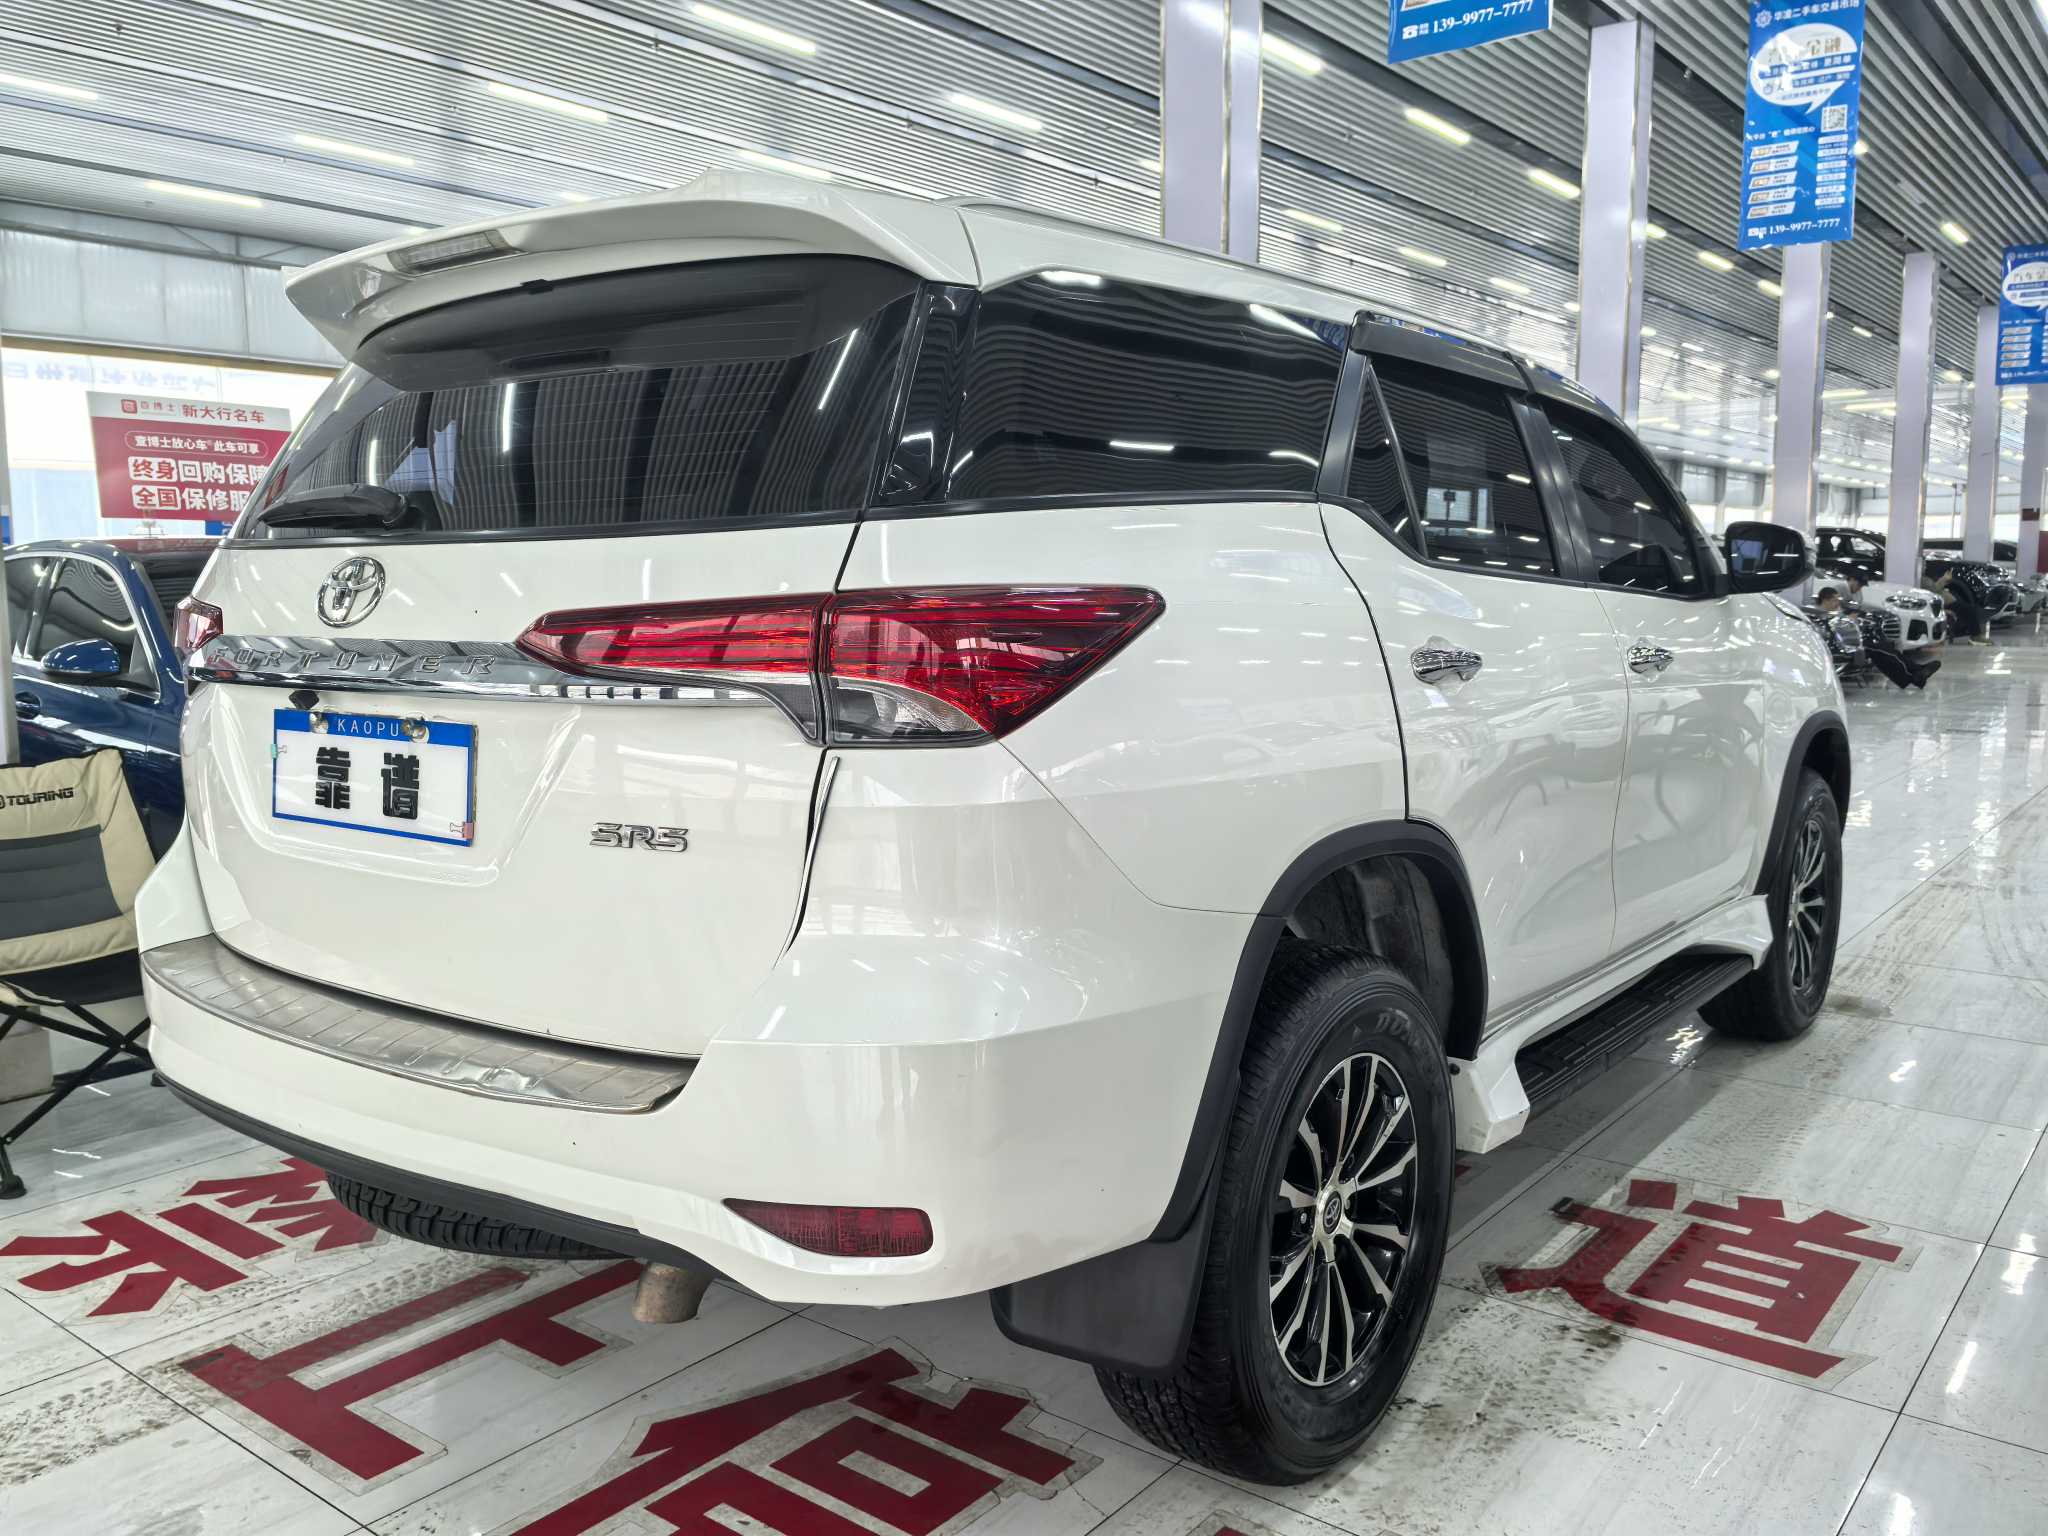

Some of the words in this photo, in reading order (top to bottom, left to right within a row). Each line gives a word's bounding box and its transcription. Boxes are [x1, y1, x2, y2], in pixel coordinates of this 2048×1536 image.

[1433, 0, 1534, 33] 139-9977-7777
[1769, 218, 1841, 235] 139-9977-7777
[182, 404, 265, 423] 新大行名车
[208, 646, 498, 675] FORTUNER
[337, 718, 400, 737] KAOPU
[6, 787, 75, 806] TOURING
[315, 747, 420, 820] 靠谱
[590, 822, 689, 852] SR5
[1499, 1178, 1904, 1379] 道
